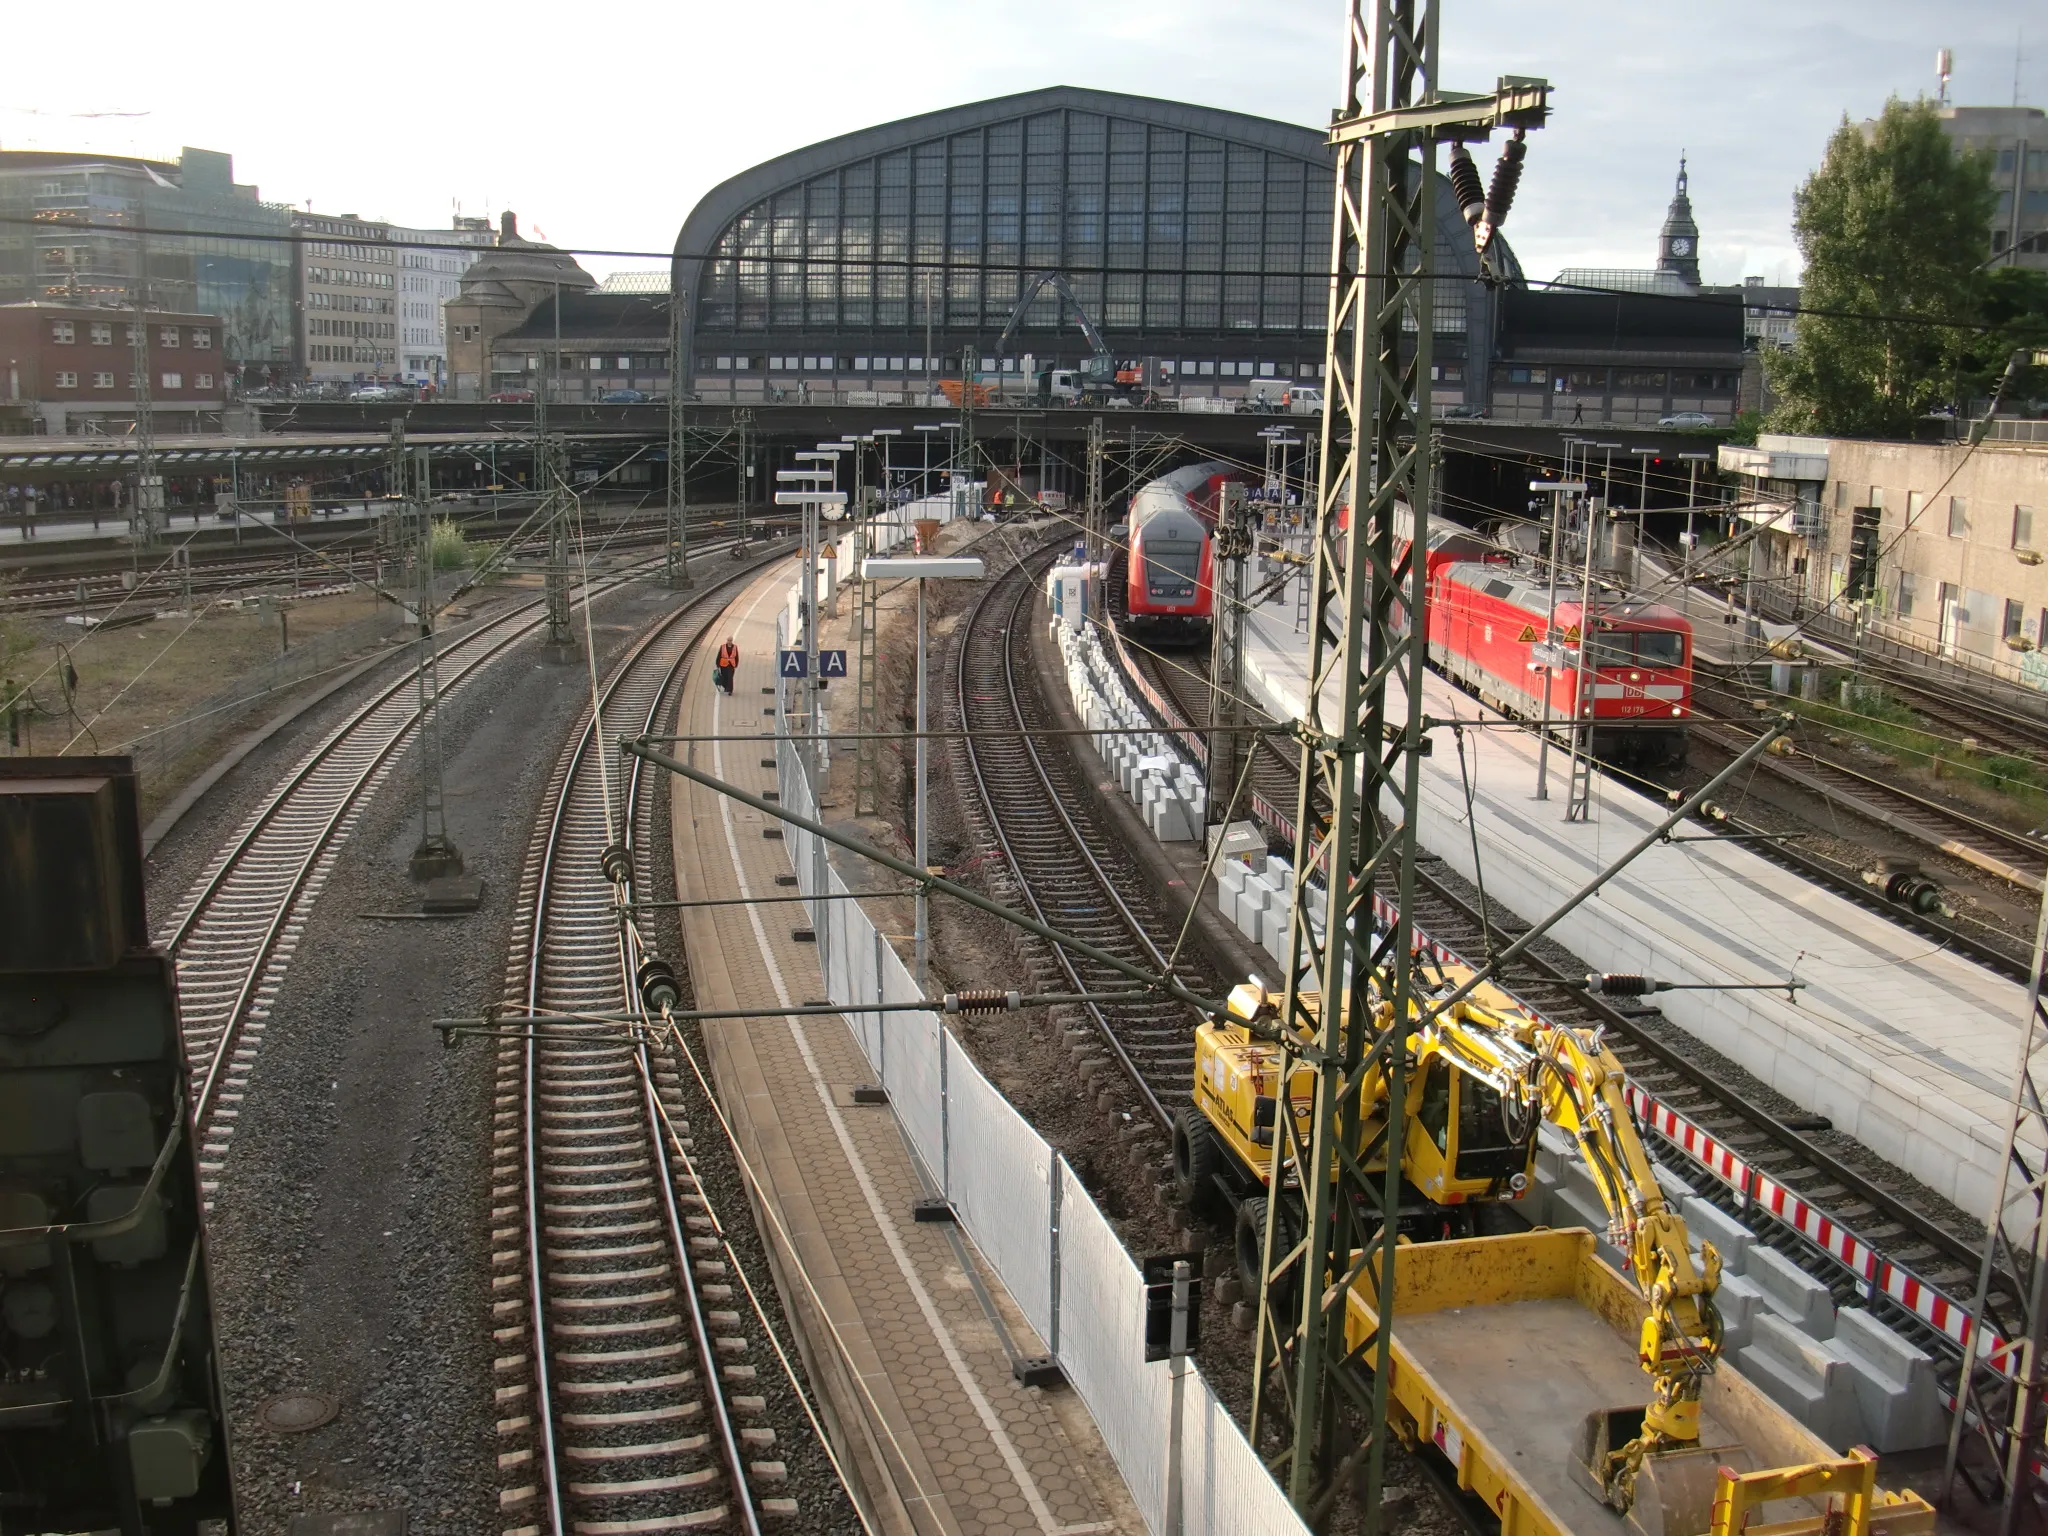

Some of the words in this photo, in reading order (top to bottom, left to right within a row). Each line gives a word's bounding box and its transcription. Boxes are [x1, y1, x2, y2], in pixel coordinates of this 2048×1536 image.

[904, 489, 910, 498] 7
[1254, 487, 1262, 497] A
[1271, 489, 1279, 498] A
[784, 652, 800, 672] A
[827, 652, 843, 672] A
[1626, 686, 1642, 697] DB
[1621, 705, 1631, 713] 112
[1215, 1094, 1234, 1123] ATLAS
